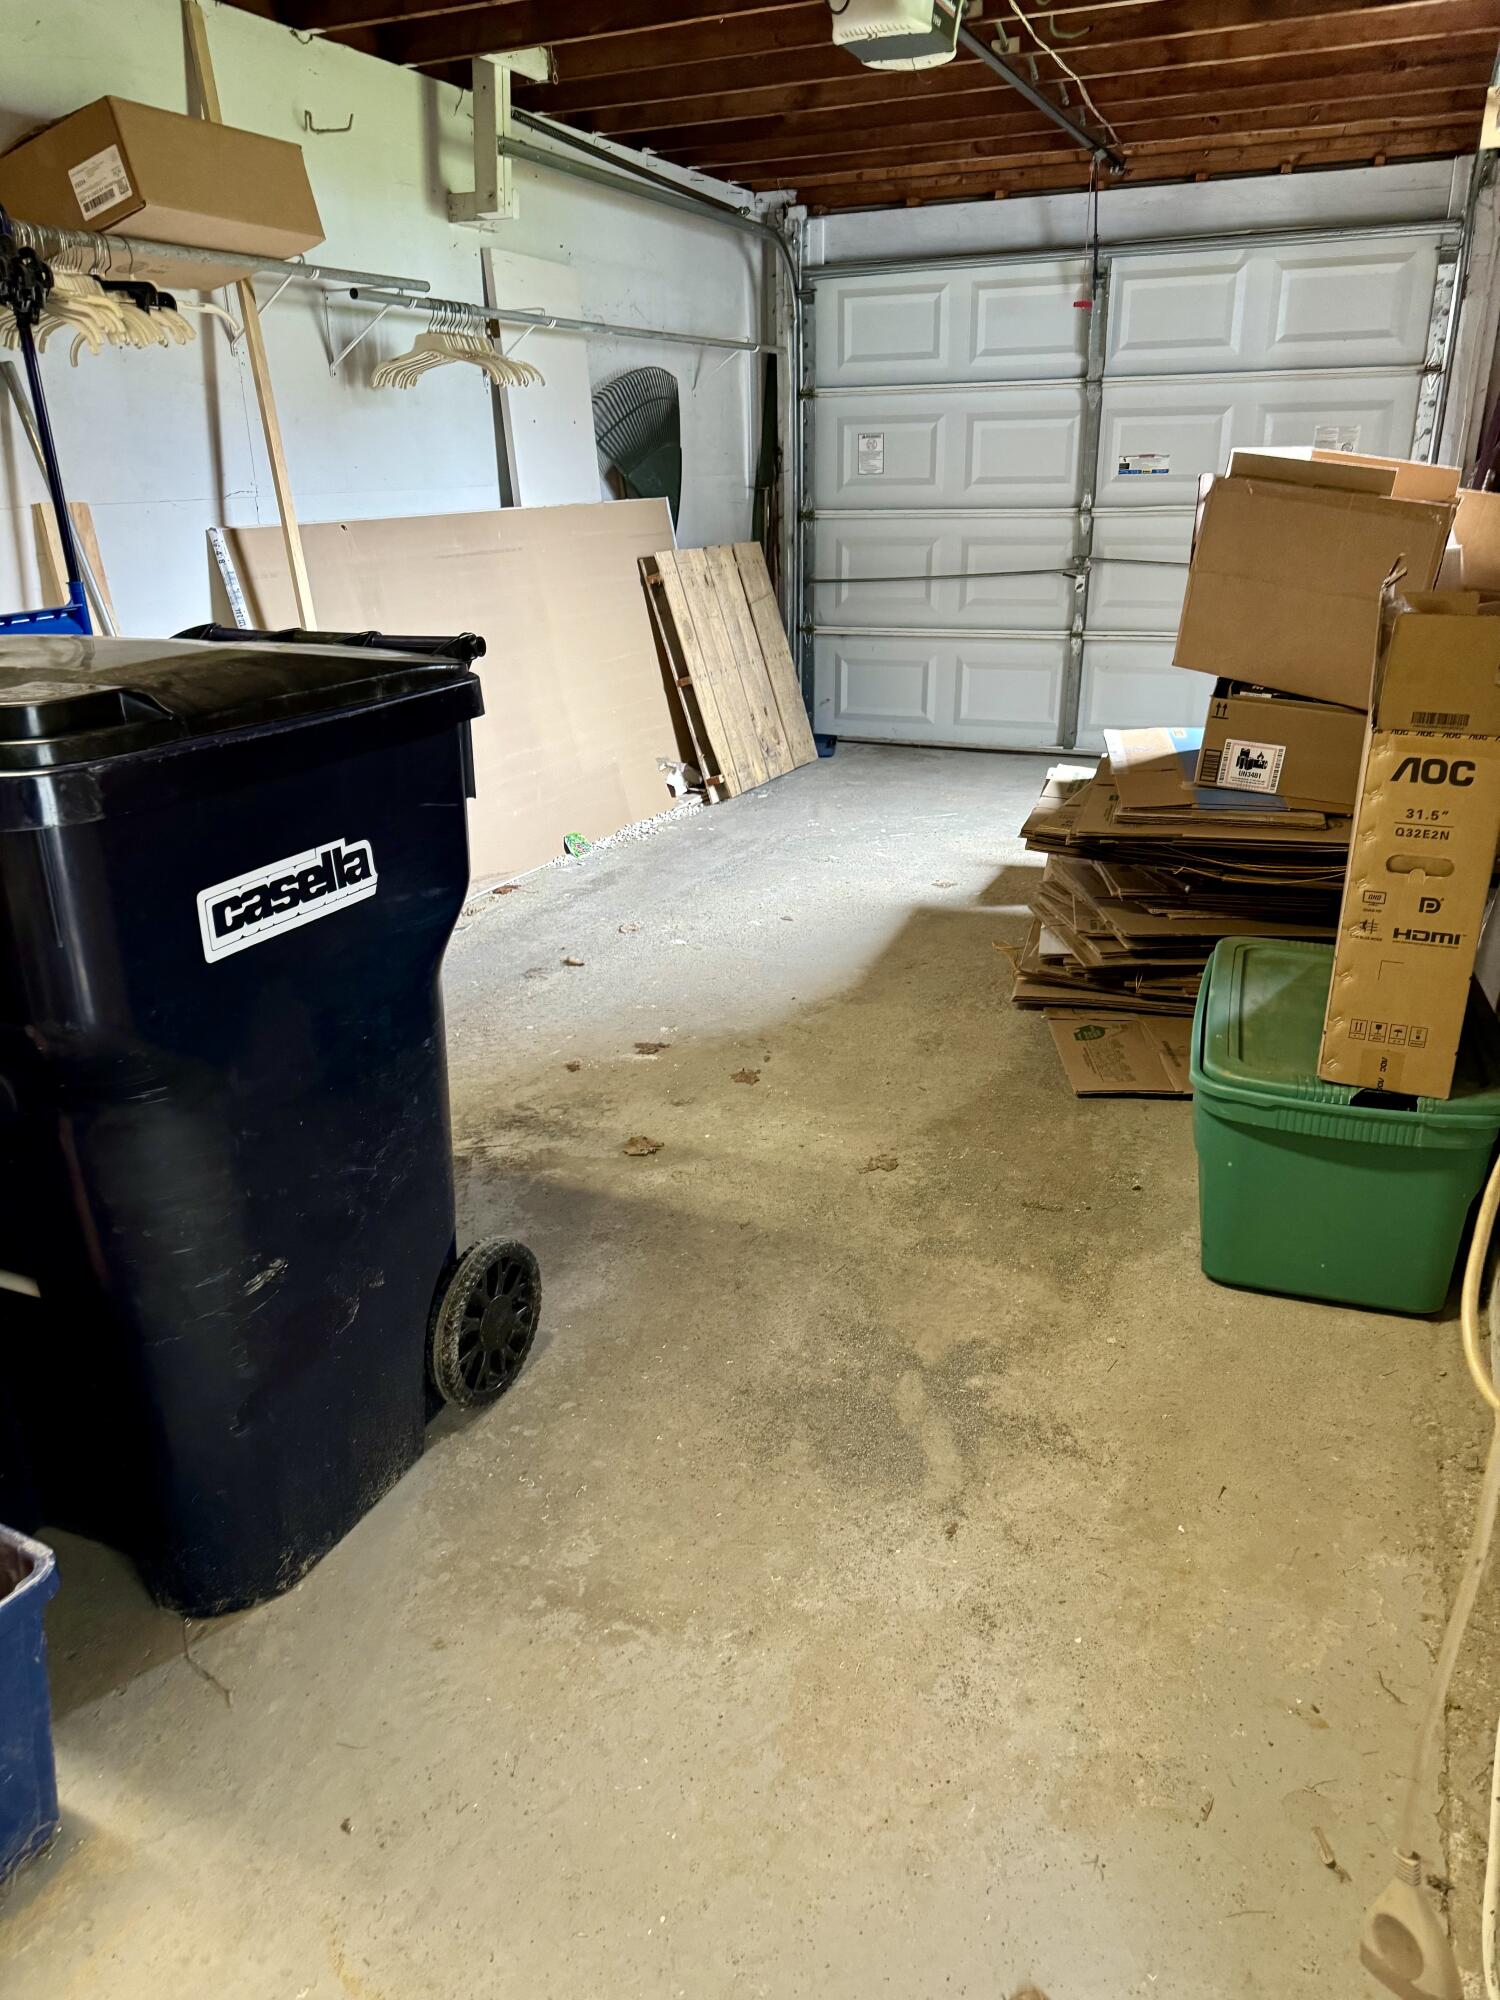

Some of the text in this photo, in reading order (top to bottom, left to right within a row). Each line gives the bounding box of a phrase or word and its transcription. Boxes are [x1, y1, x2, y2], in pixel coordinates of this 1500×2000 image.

[1238, 769, 1262, 779] UN3481
[1390, 757, 1476, 787] AOC
[1395, 827, 1450, 841] Q32E2N
[211, 845, 373, 939] casella
[1392, 927, 1462, 945] HDMI
